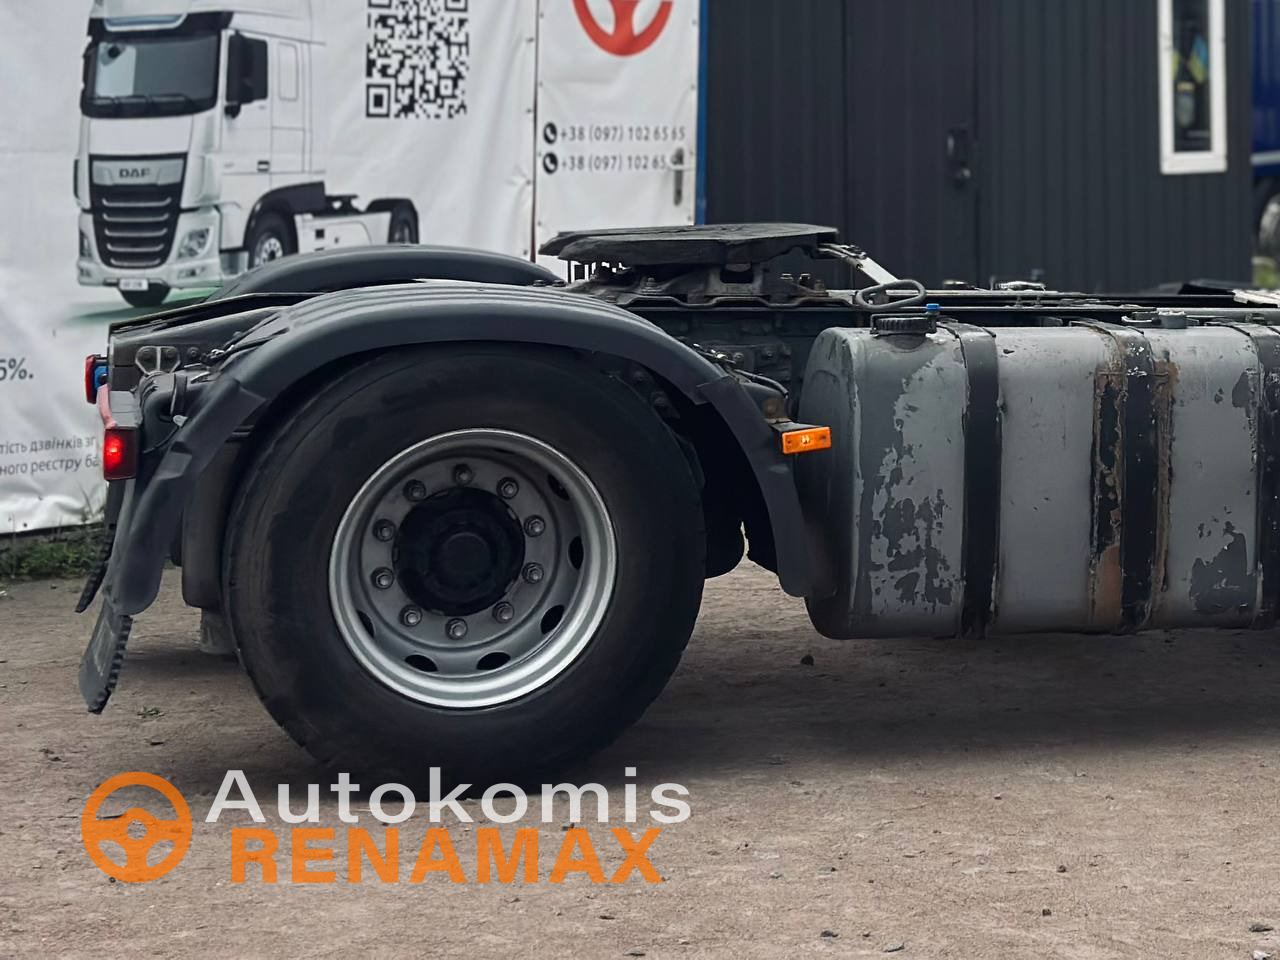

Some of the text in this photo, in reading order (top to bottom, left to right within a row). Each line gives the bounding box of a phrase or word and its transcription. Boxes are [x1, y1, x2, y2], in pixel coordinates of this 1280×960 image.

[560, 126, 585, 140] +38
[589, 125, 624, 141] (097)
[628, 126, 650, 140] 102
[562, 156, 585, 170] +38
[588, 155, 622, 171] (097)
[627, 156, 648, 170] 102
[119, 168, 150, 178] DAF
[31, 458, 82, 477] реєстру
